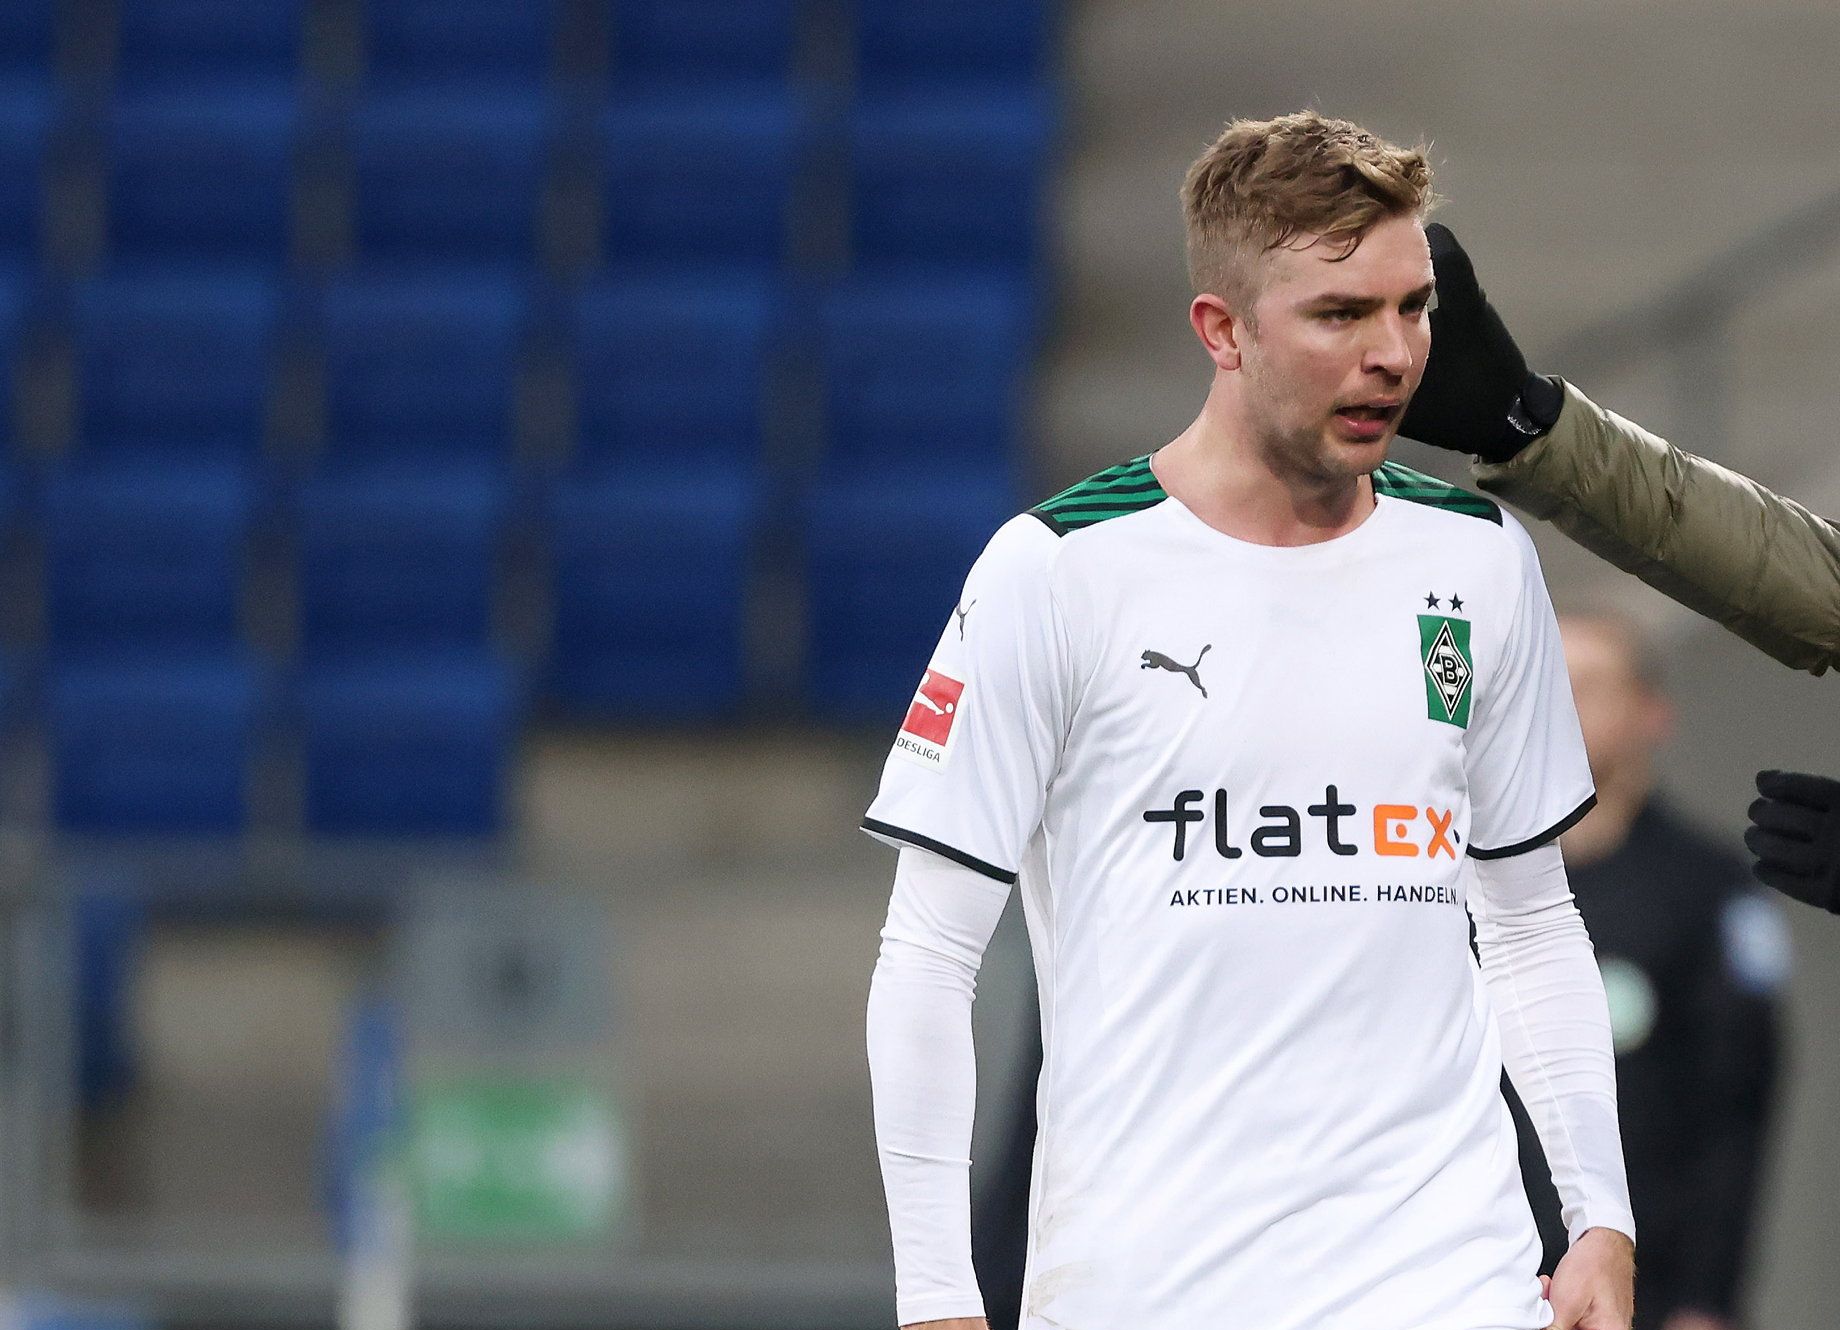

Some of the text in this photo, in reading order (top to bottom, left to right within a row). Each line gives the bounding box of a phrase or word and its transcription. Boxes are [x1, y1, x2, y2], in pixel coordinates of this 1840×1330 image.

[1440, 654, 1460, 686] B
[1170, 887, 1264, 907] AKTIEN.
[1272, 885, 1367, 904] ONLINE.
